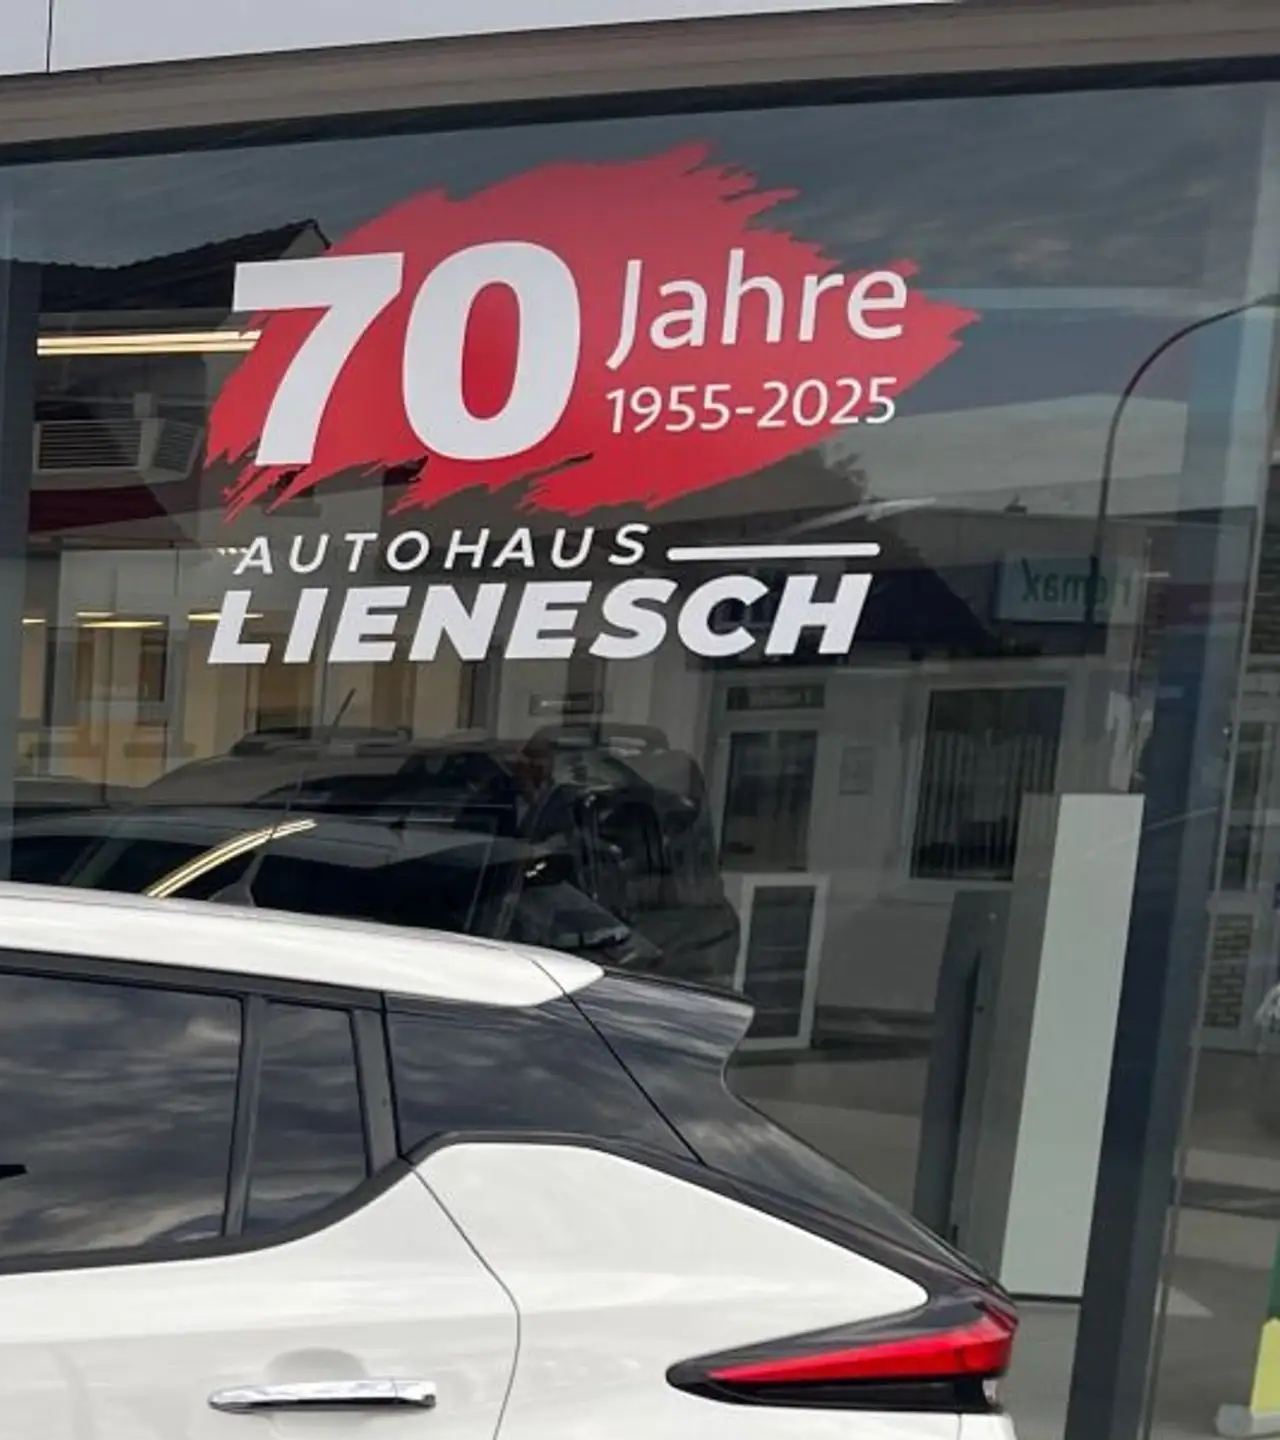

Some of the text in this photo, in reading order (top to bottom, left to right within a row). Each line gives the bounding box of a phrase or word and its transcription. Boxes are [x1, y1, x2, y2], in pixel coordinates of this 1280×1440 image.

[232, 241, 580, 467] 70
[606, 249, 907, 370] Jahre
[606, 376, 897, 434] 1955-2025
[233, 522, 650, 576] AUTOHAUS
[207, 573, 874, 665] LIENESCH
